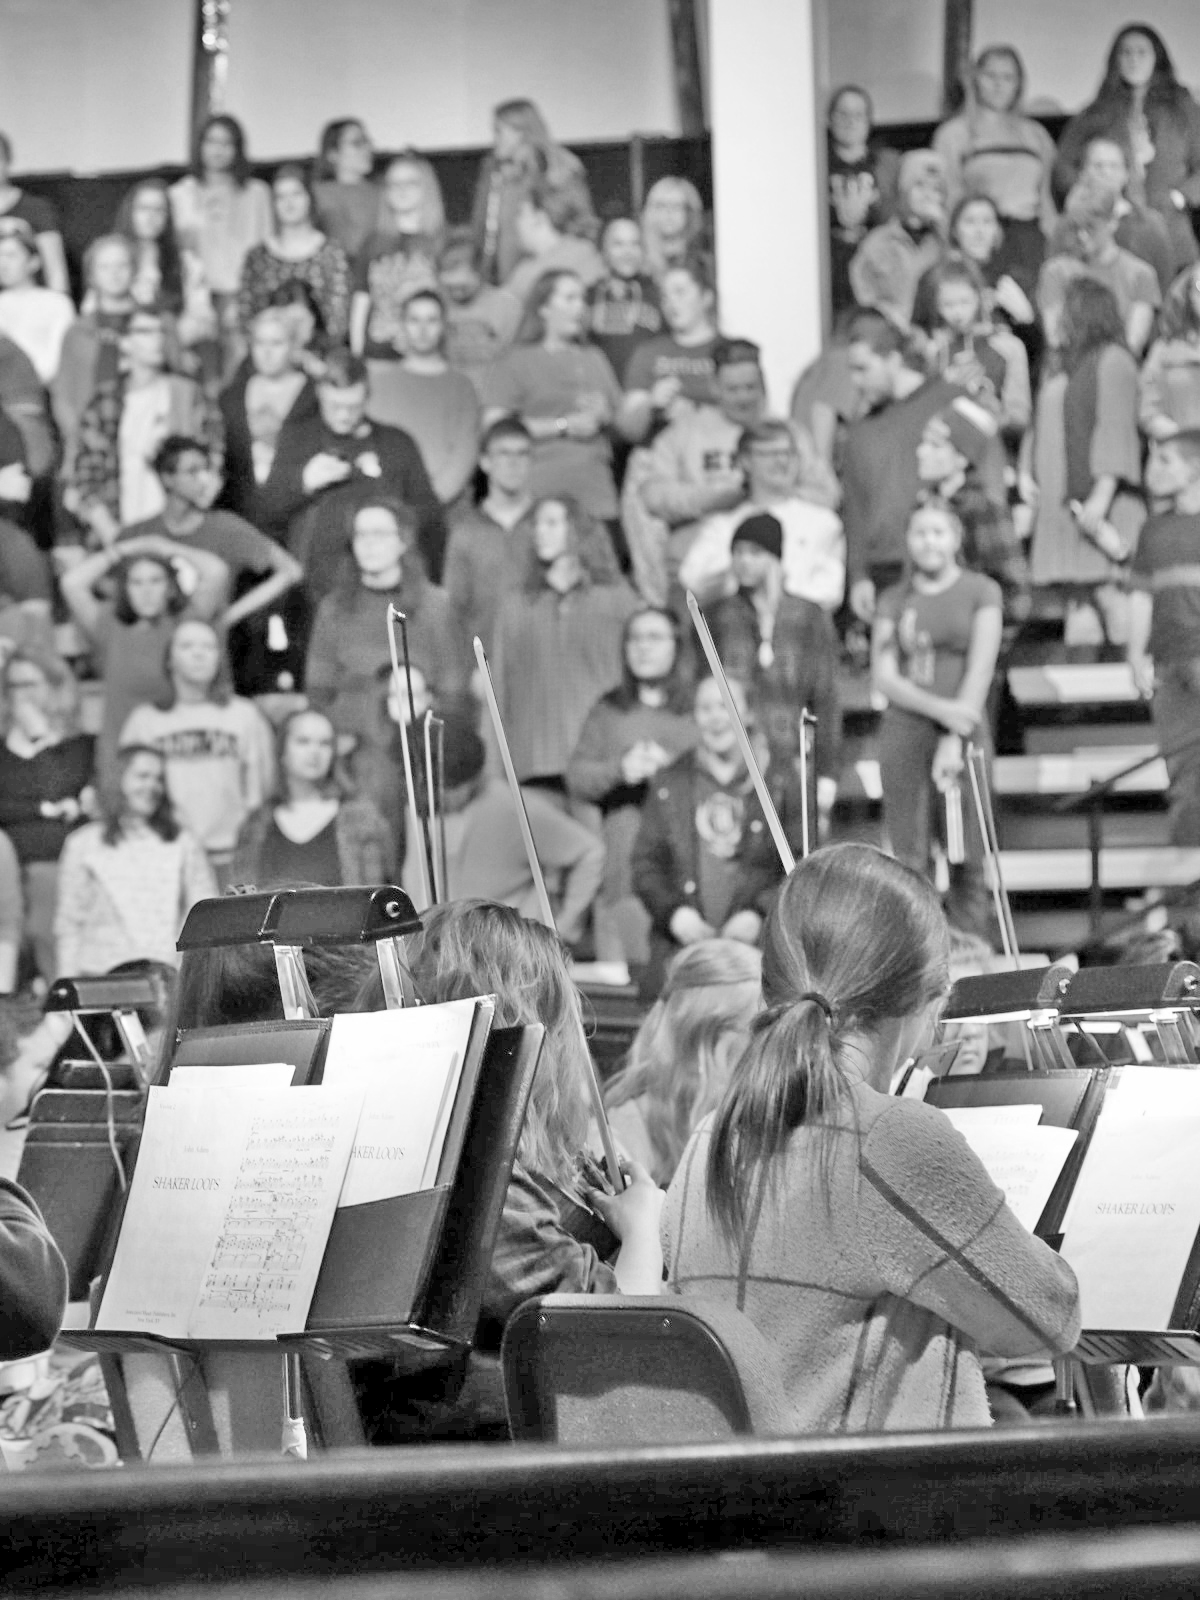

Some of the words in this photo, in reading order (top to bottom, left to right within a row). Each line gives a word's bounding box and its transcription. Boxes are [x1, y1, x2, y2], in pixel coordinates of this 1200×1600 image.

[351, 1145, 375, 1159] AKER
[376, 1146, 406, 1160] LOOPS
[152, 1176, 191, 1190] SHAKER
[191, 1177, 221, 1191] LOOPS
[1095, 1202, 1138, 1215] SHAKER
[1139, 1202, 1176, 1215] LOOPS
